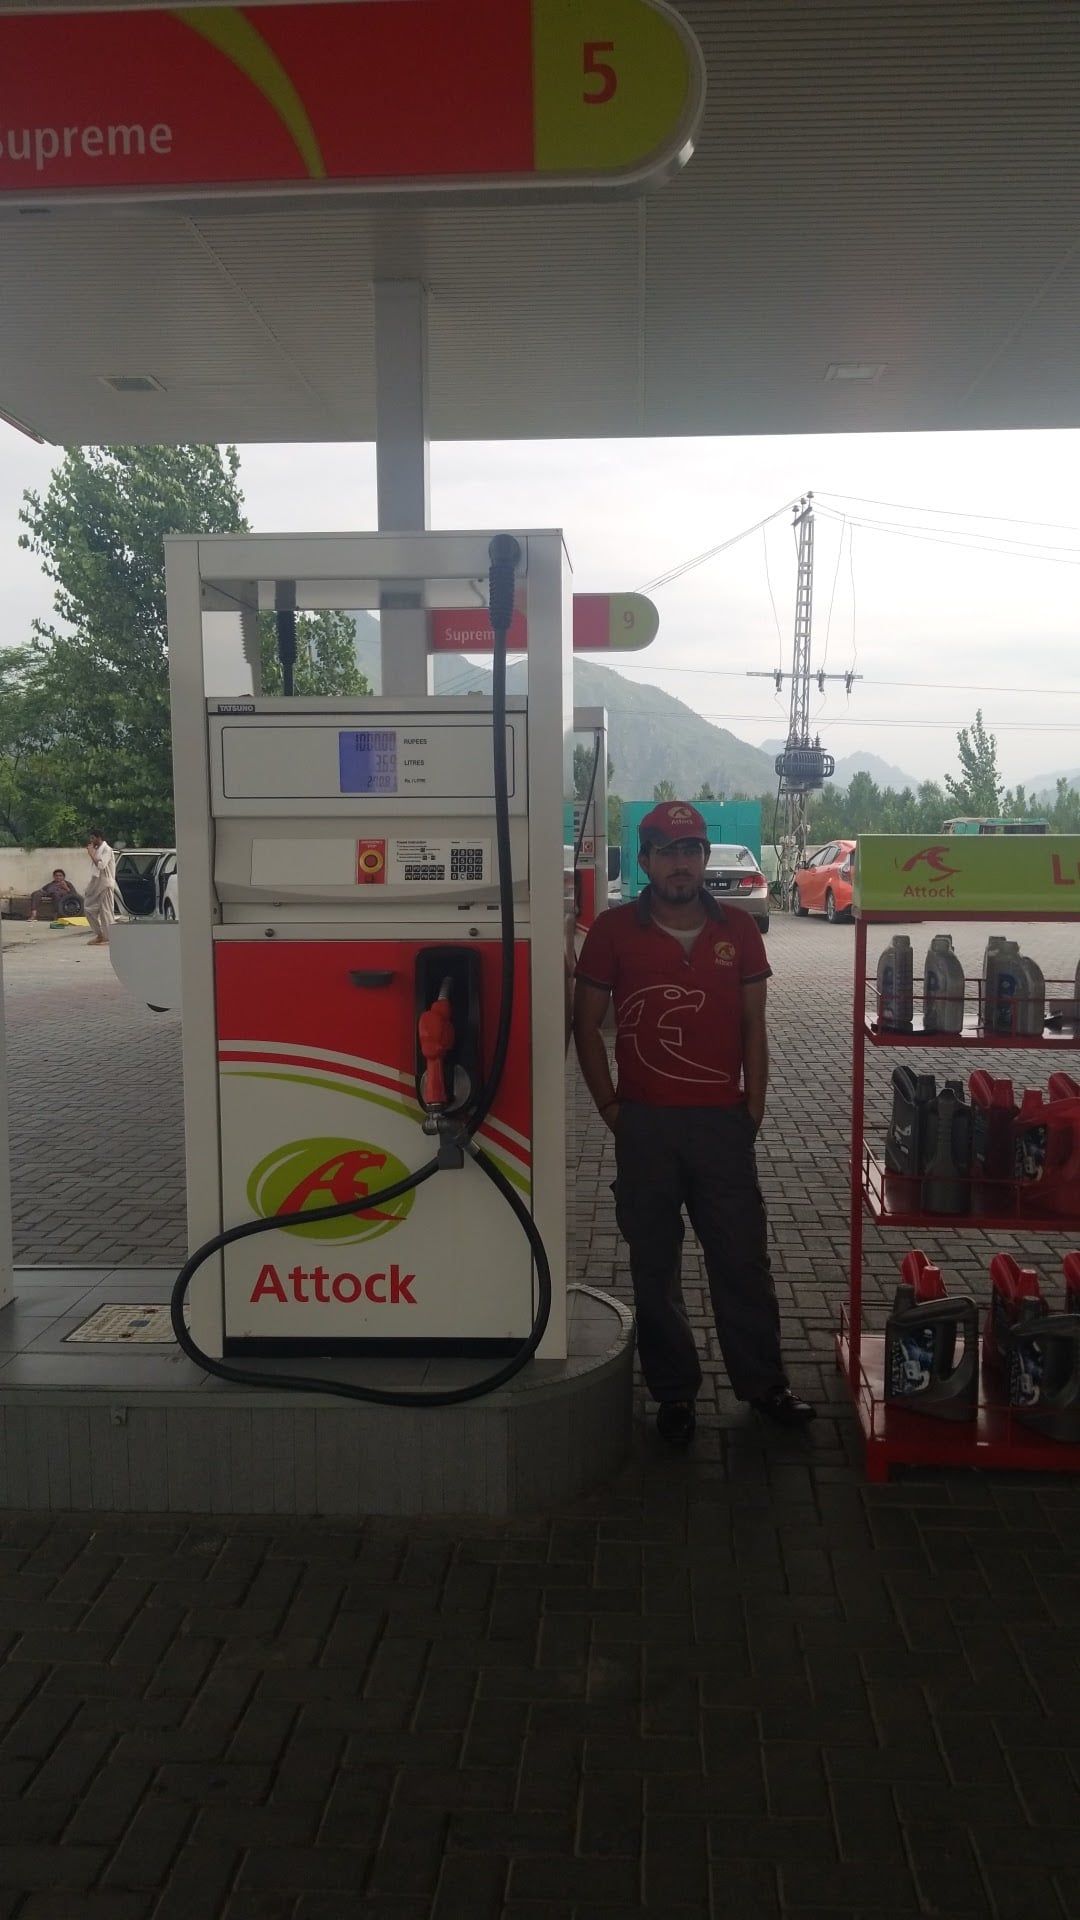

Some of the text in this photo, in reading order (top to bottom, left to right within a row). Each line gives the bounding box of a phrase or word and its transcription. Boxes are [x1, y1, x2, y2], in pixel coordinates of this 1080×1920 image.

[582, 42, 618, 104] 5
[0, 122, 173, 170] upreme
[445, 628, 496, 643] Suprem
[623, 611, 635, 629] 9
[1052, 854, 1080, 885] L
[903, 885, 955, 898] Attock
[250, 1264, 418, 1305] Attock
